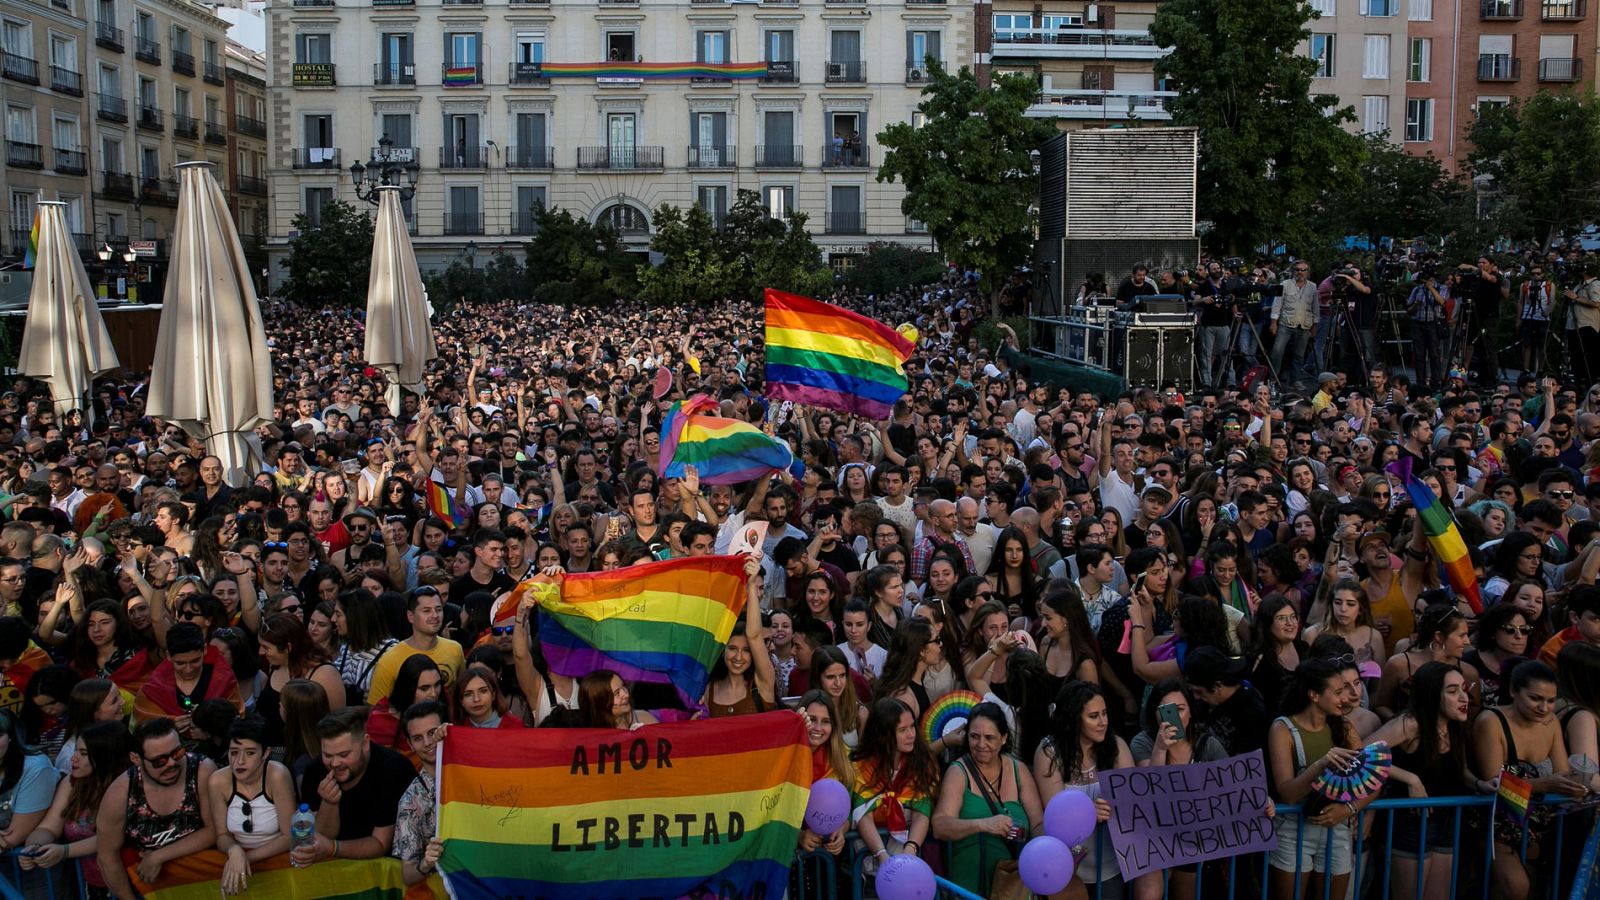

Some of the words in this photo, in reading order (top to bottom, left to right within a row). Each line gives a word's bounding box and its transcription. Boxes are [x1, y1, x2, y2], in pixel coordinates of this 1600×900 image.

[570, 737, 673, 775] AMOR
[1108, 772, 1167, 800] POR
[1167, 771, 1200, 793] EL
[1202, 757, 1262, 791] AMOR
[551, 811, 745, 852] LIBERTAD
[1114, 803, 1151, 835] LA
[1152, 786, 1268, 827] LIBERTAD
[1115, 844, 1131, 874] Y
[1131, 838, 1166, 871] LA
[1159, 815, 1275, 858] VISIBILIDAD
